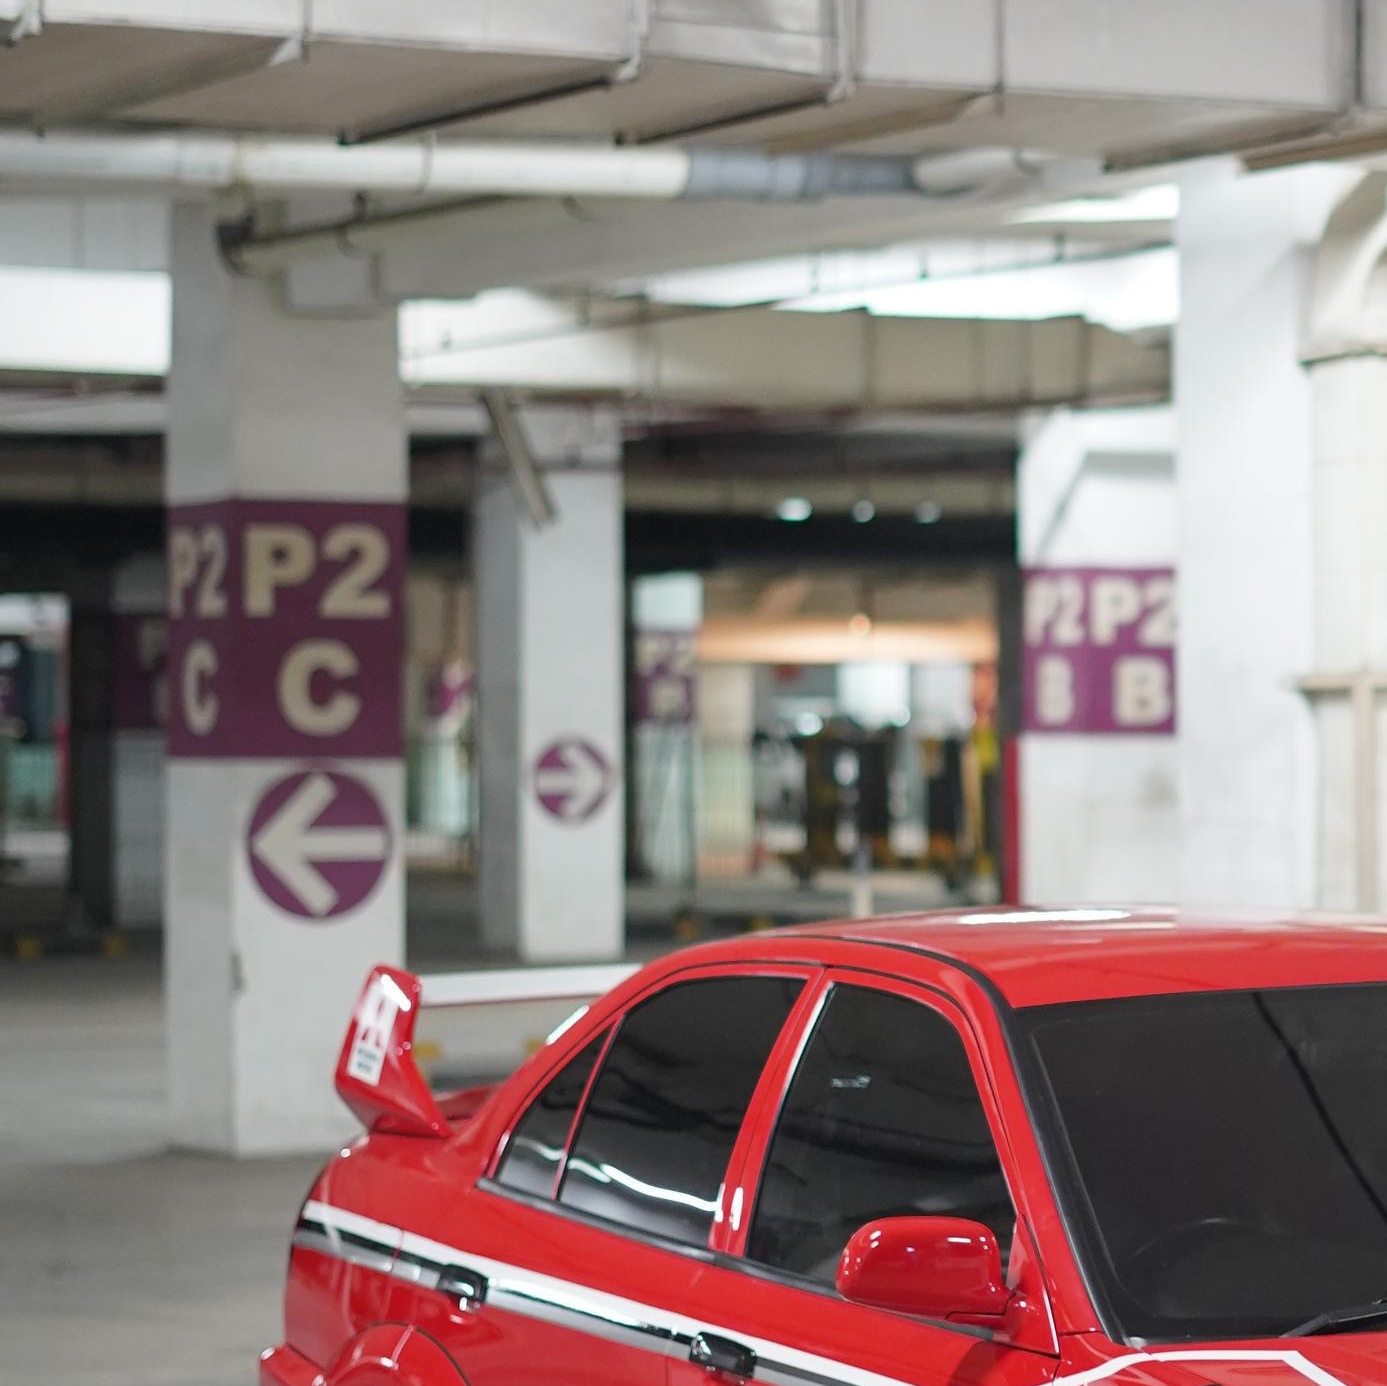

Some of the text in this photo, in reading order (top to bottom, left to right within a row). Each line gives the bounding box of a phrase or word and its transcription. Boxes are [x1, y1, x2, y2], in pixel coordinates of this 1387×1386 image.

[168, 525, 227, 618] P2
[244, 522, 391, 619] P2
[1023, 575, 1084, 647] P2
[1089, 575, 1175, 647] P2
[182, 639, 219, 736] C
[277, 637, 361, 737] C
[1113, 655, 1170, 727] B
